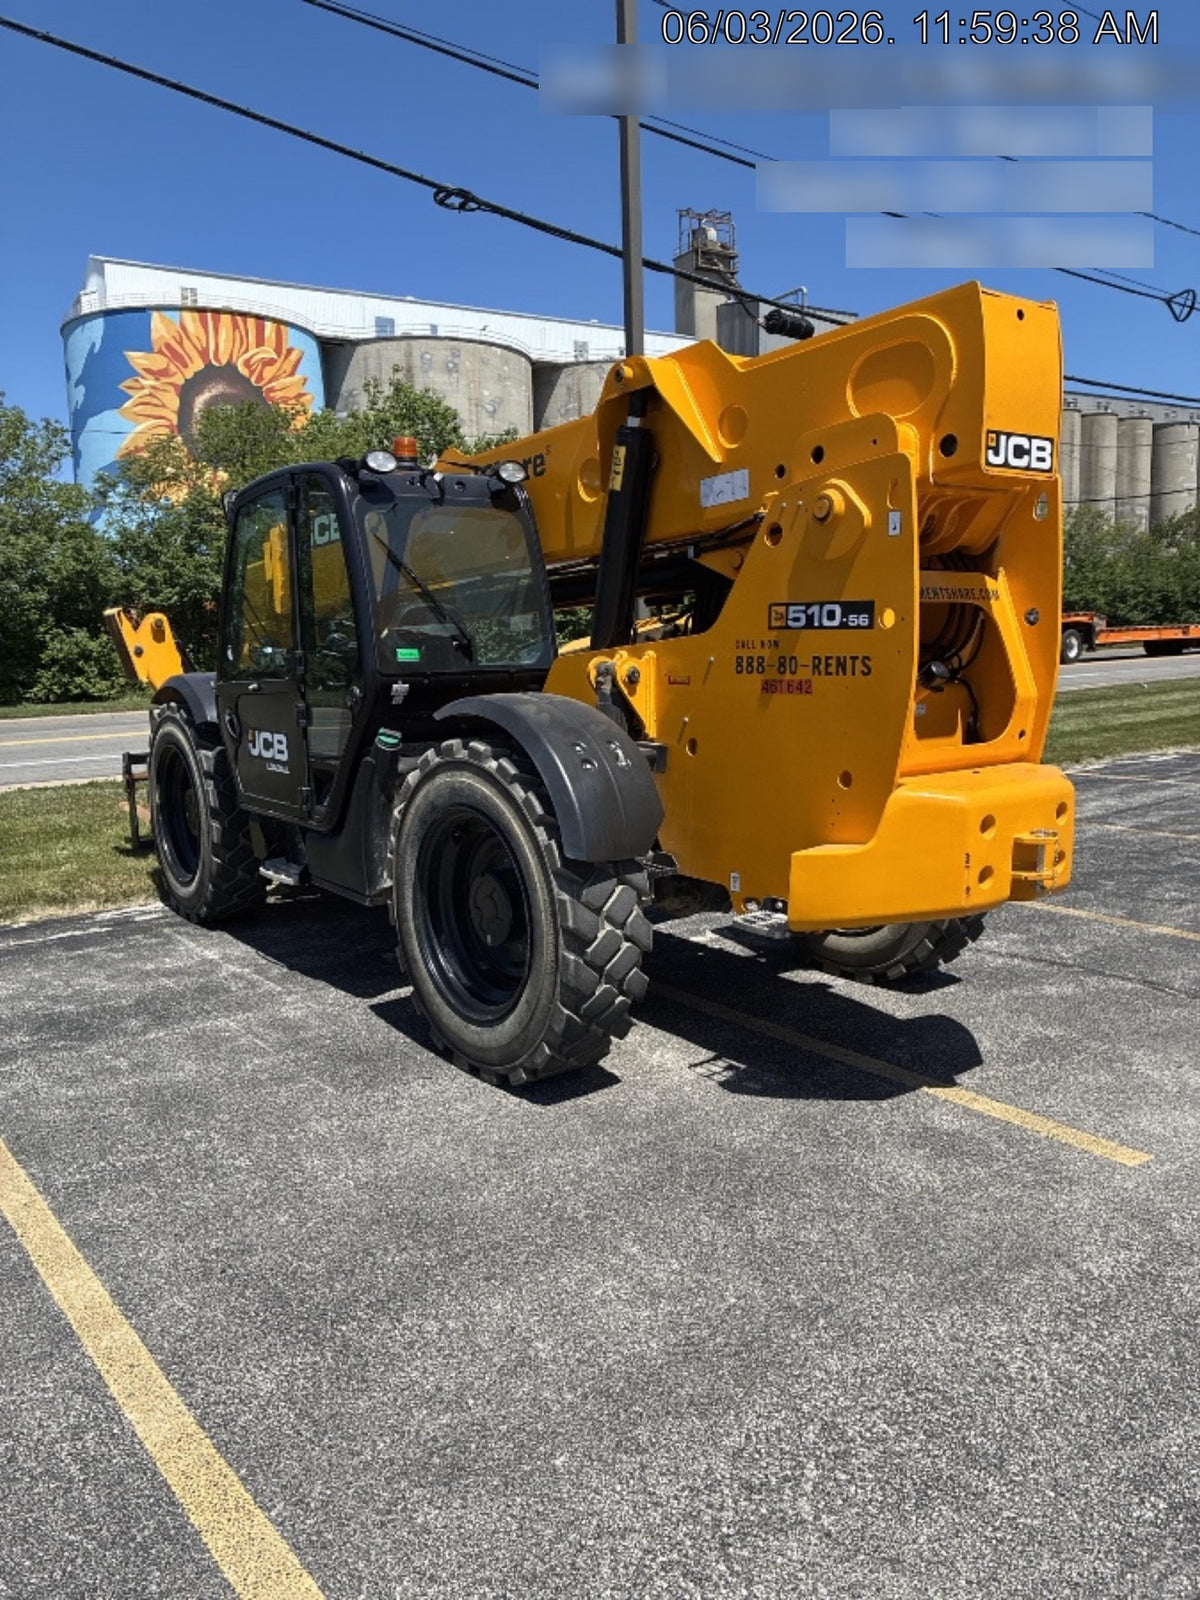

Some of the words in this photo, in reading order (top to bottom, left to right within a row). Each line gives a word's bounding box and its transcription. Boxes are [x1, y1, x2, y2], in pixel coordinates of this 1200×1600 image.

[987, 434, 1052, 470] JCB
[735, 640, 756, 649] CALL
[760, 640, 780, 649] NOW
[735, 656, 872, 676] 888-80-RENTS
[248, 730, 288, 761] JCB
